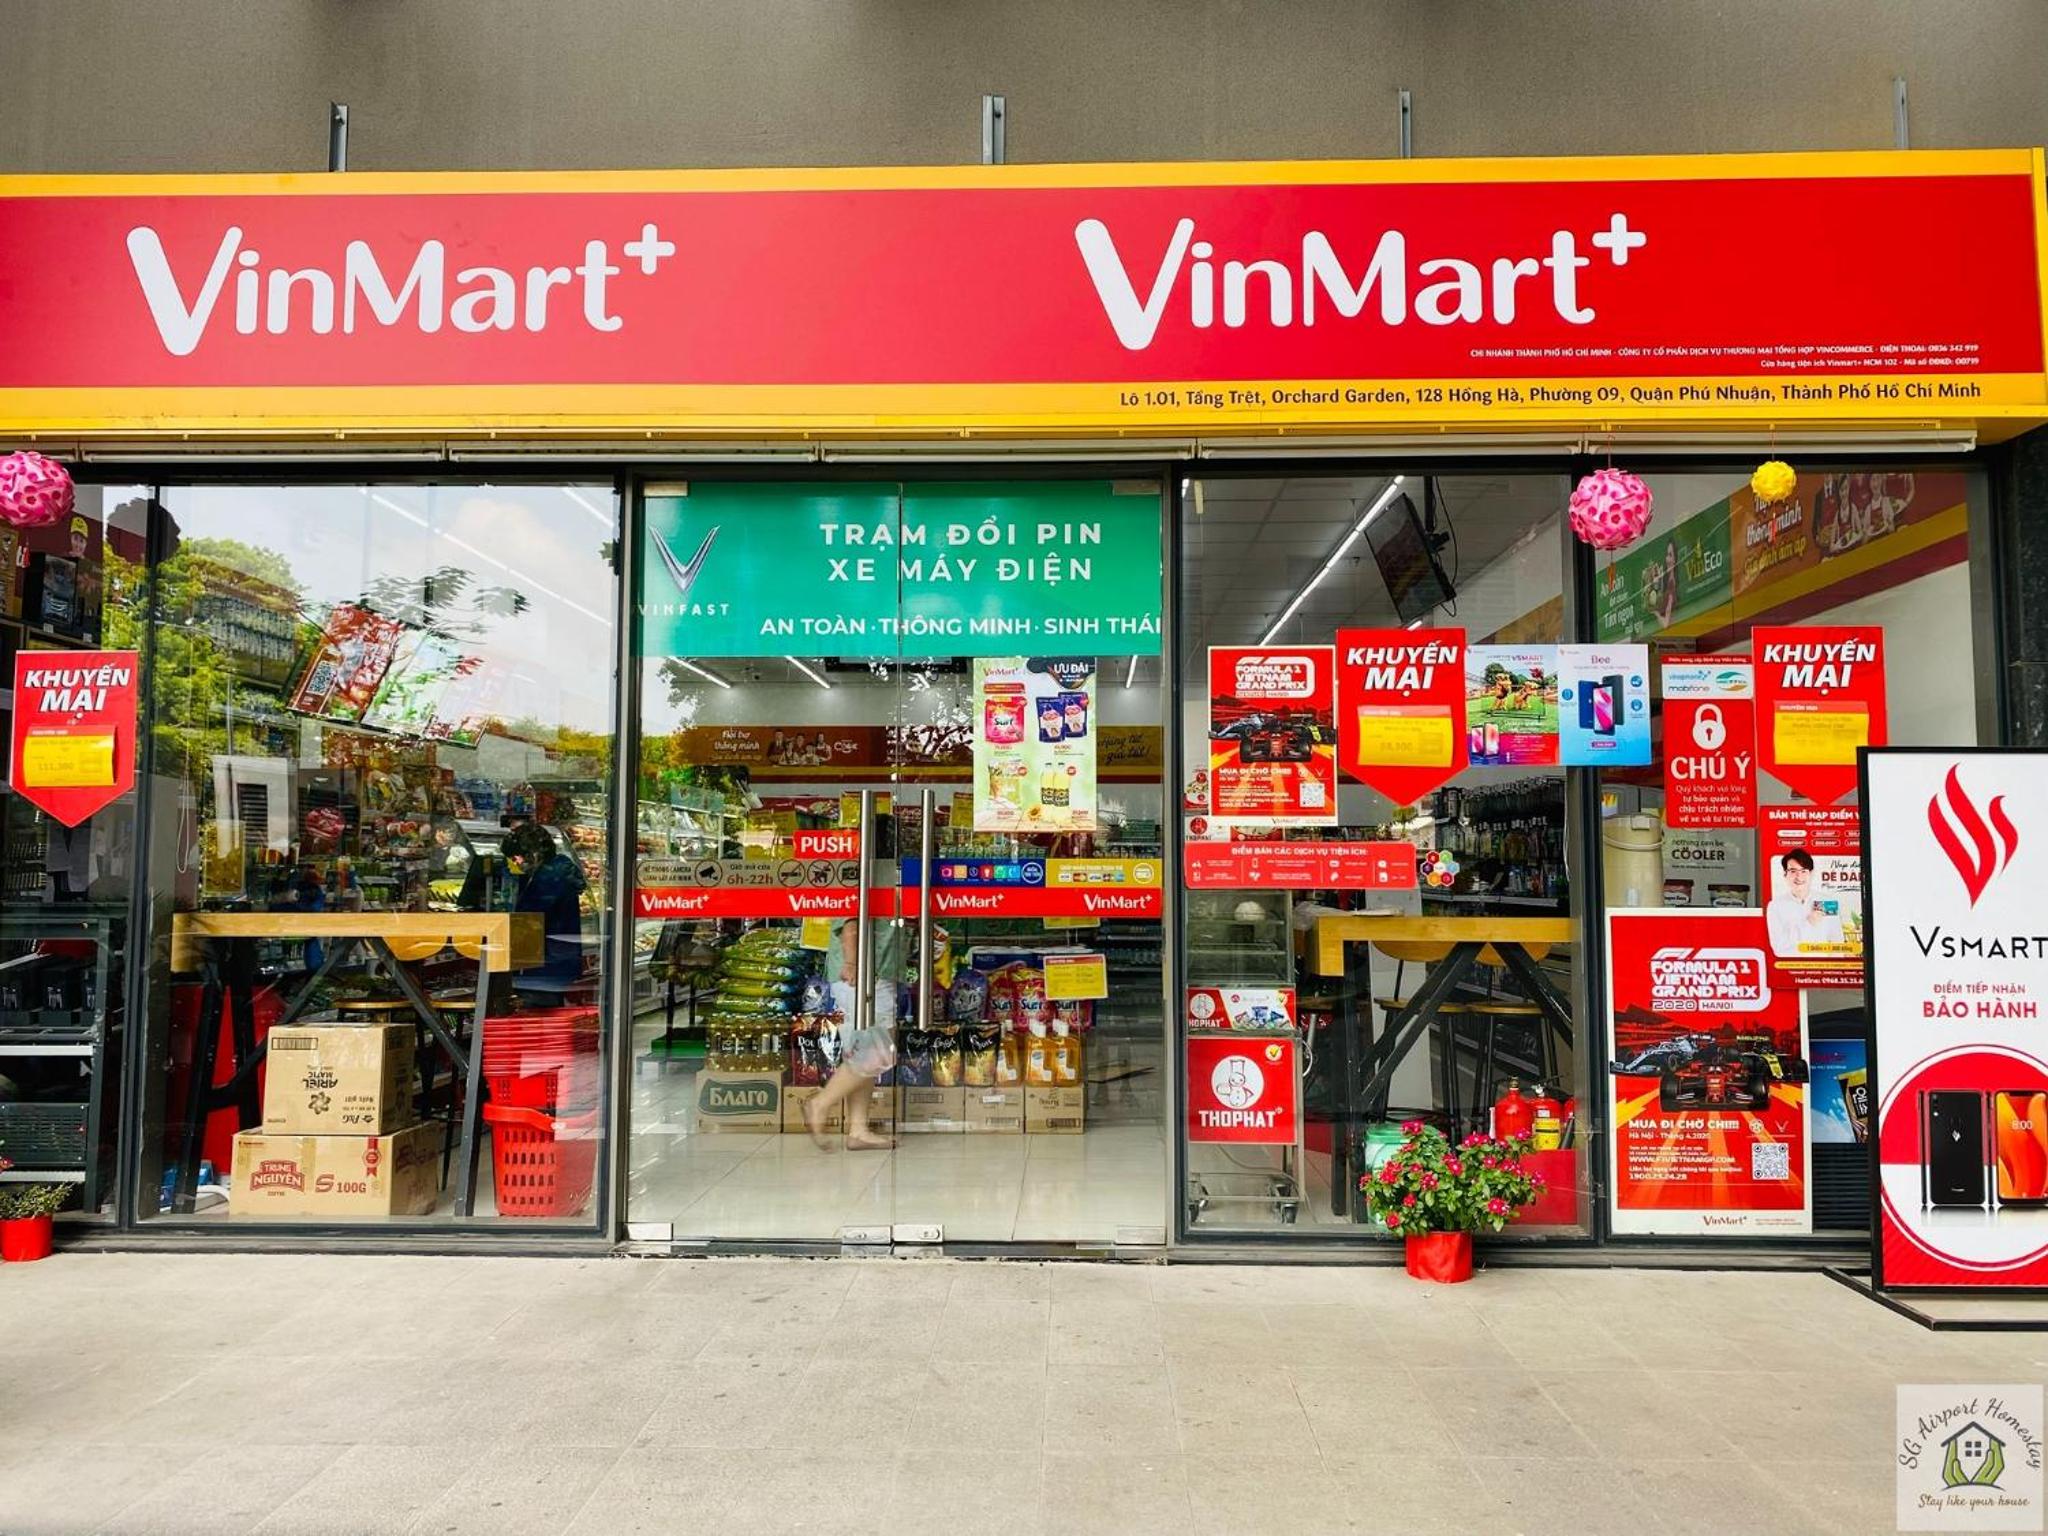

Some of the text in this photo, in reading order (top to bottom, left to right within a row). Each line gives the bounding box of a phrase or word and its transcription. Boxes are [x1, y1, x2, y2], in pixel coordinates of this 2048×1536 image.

[127, 224, 676, 356] VinMart+
[1074, 213, 1647, 351] VinMart+
[1121, 392, 1139, 406] Lô
[1186, 390, 1224, 410] Tầng
[1229, 390, 1266, 406] Trệt,
[1272, 388, 1340, 404] Orchard
[1345, 388, 1410, 405] Garden,
[1416, 388, 1443, 403] 128
[1448, 387, 1493, 406] Hồng
[1498, 387, 1524, 404] Hà,
[1530, 387, 1593, 404] Phường
[1630, 387, 1673, 404] Quận
[1679, 386, 1710, 401] Phú
[1717, 386, 1776, 402] Nhuận,
[1781, 384, 1832, 399] Thành
[1838, 382, 1870, 399] Phố
[1876, 382, 1899, 398] Hồ
[1905, 383, 1932, 398] Chí
[1938, 383, 1981, 398] Minh
[820, 515, 1102, 551] TRẠM ĐỔI PIN
[828, 552, 1093, 586] XE MÁY ĐIỆN
[638, 604, 730, 616] VINFAST
[760, 611, 1162, 636] AN TOÀN THÔNG MINH SINH THÁI
[1347, 640, 1459, 665] KHUYẾN
[1764, 638, 1876, 663] KHUYẾN
[24, 663, 130, 688] KHUYẾN
[1364, 667, 1435, 697] MẠI
[1782, 664, 1852, 695] MẠI
[40, 690, 107, 721] MẠI
[1670, 750, 1751, 780] CHÚ Ý
[801, 836, 852, 854] PUSH
[728, 874, 773, 885] 6h-22h
[640, 894, 710, 912] VinMart+
[788, 894, 858, 912] VinMart+
[936, 892, 1005, 911] VinMart+
[1084, 894, 1153, 911] VinMart+
[1910, 926, 2048, 959] VSMART
[1651, 961, 1750, 974] FORMULA 1
[1652, 974, 1736, 985] VIETNAM
[1934, 980, 2026, 997] ĐIỂM TIẾP NHẬN
[1652, 986, 1759, 998] GRAND PRIX
[1654, 1000, 1734, 1010] 2020 HANOI
[1923, 996, 2038, 1019] BẢO HÀNH
[302, 1079, 339, 1089] ARIEL
[1199, 1110, 1277, 1128] THOPHAT
[1629, 1120, 1657, 1129] MUA
[1661, 1120, 1675, 1129] ĐI
[2012, 1120, 2033, 1130] 8:00
[315, 1174, 366, 1193] S 100G
[1702, 1215, 1748, 1227] VinMart+
